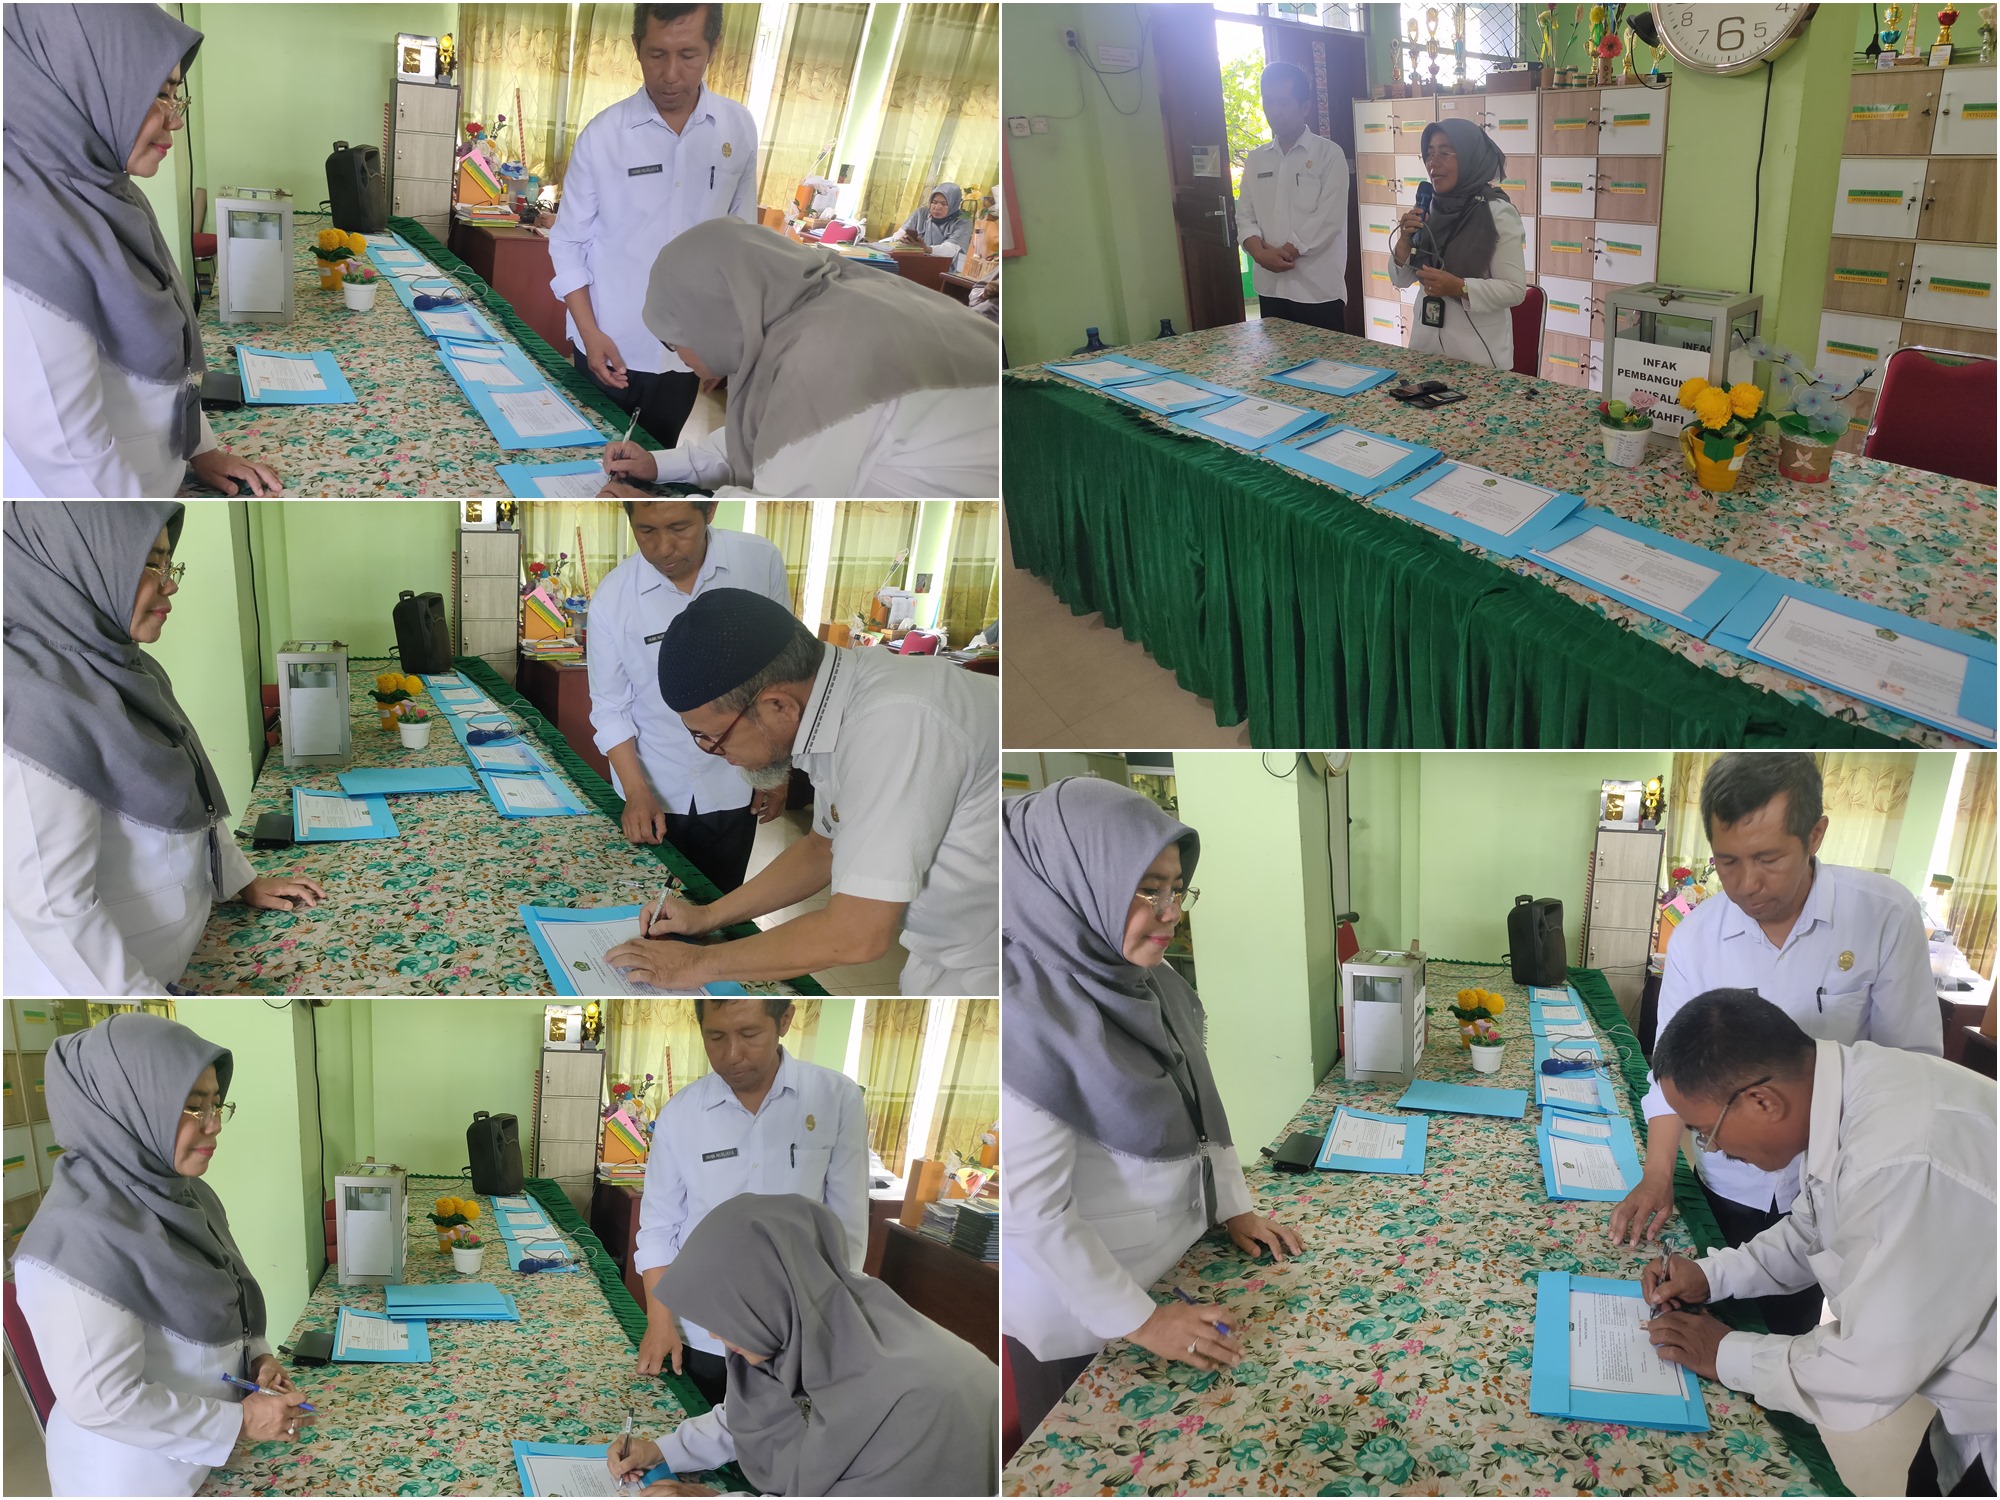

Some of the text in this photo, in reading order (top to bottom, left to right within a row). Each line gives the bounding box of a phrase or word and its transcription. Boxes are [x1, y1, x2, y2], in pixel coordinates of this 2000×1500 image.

[1775, 3, 1789, 13] 4
[1681, 11, 1693, 27] 8
[1698, 29, 1709, 45] 7
[1716, 16, 1745, 51] 6
[1753, 22, 1767, 38] 5
[1643, 357, 1677, 371] INFAK
